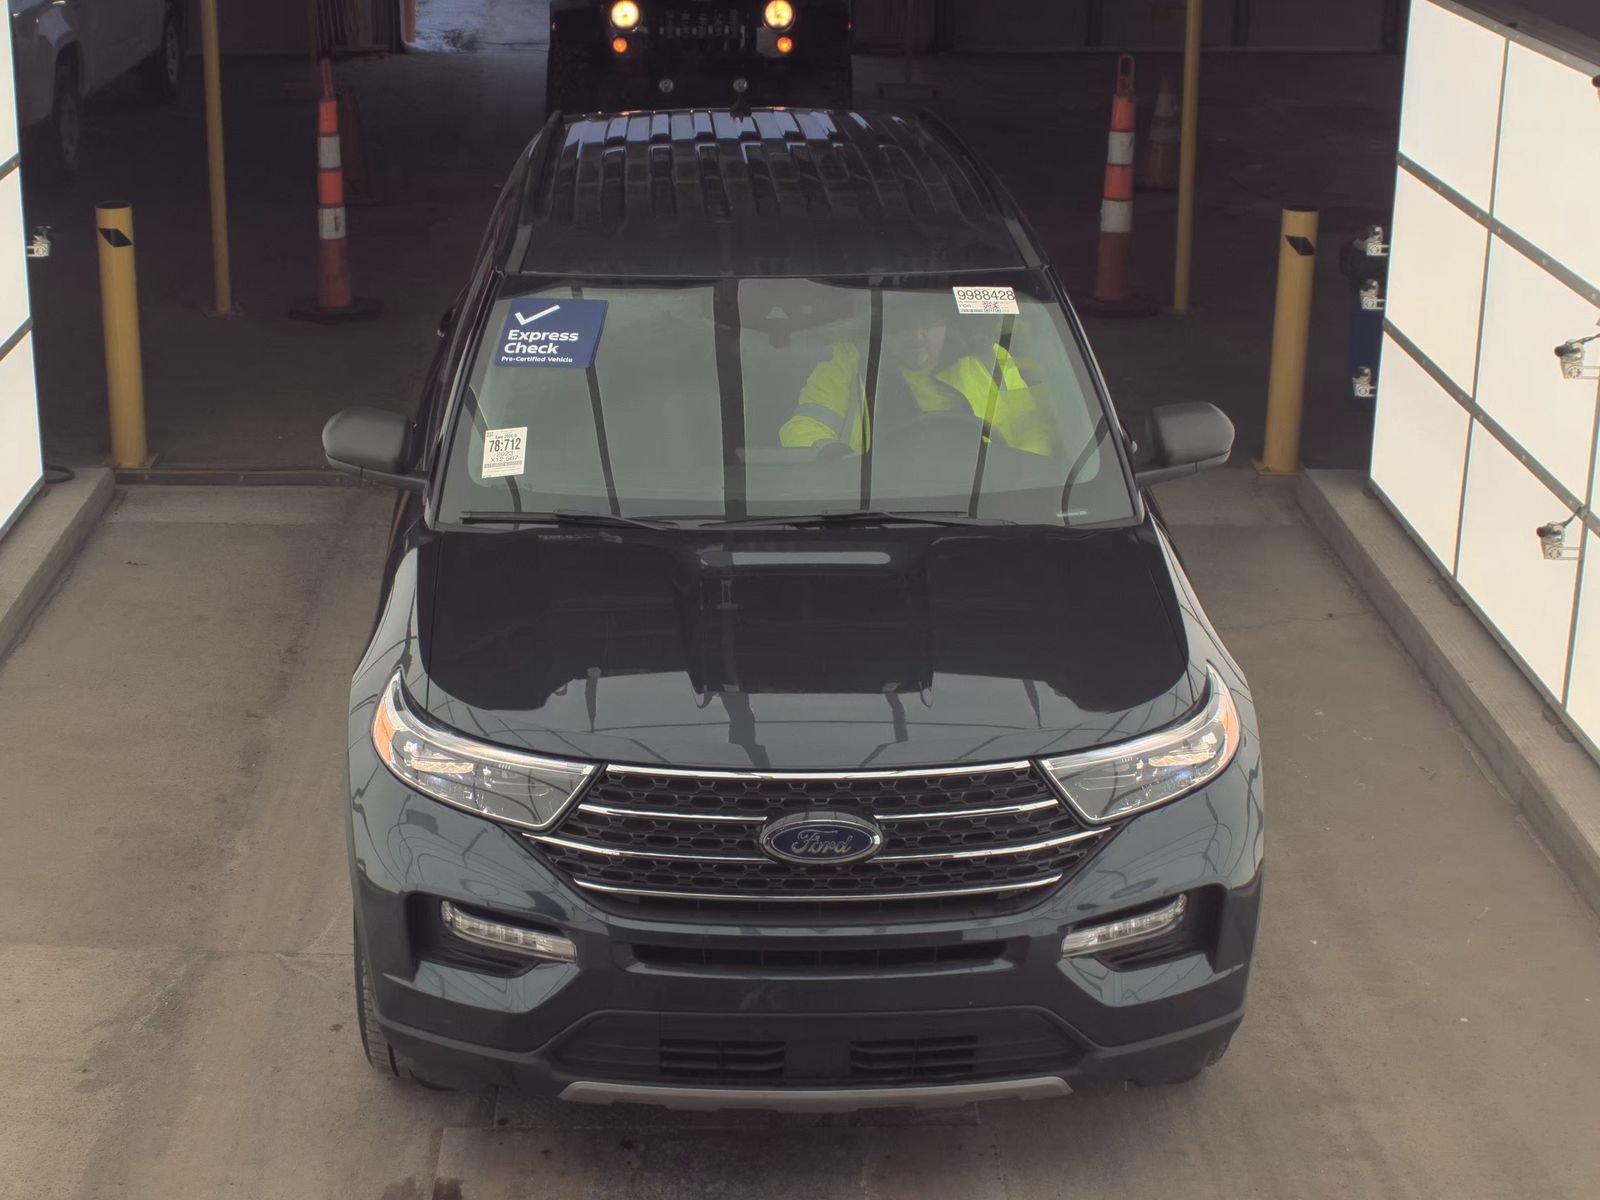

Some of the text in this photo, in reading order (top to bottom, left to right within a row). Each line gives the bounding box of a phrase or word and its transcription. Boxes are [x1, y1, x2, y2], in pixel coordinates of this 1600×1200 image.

[957, 289, 1015, 301] 9988428
[507, 329, 579, 343] Express
[504, 342, 559, 354] Check
[489, 437, 522, 453] 78:712
[791, 830, 854, 854] Ford
